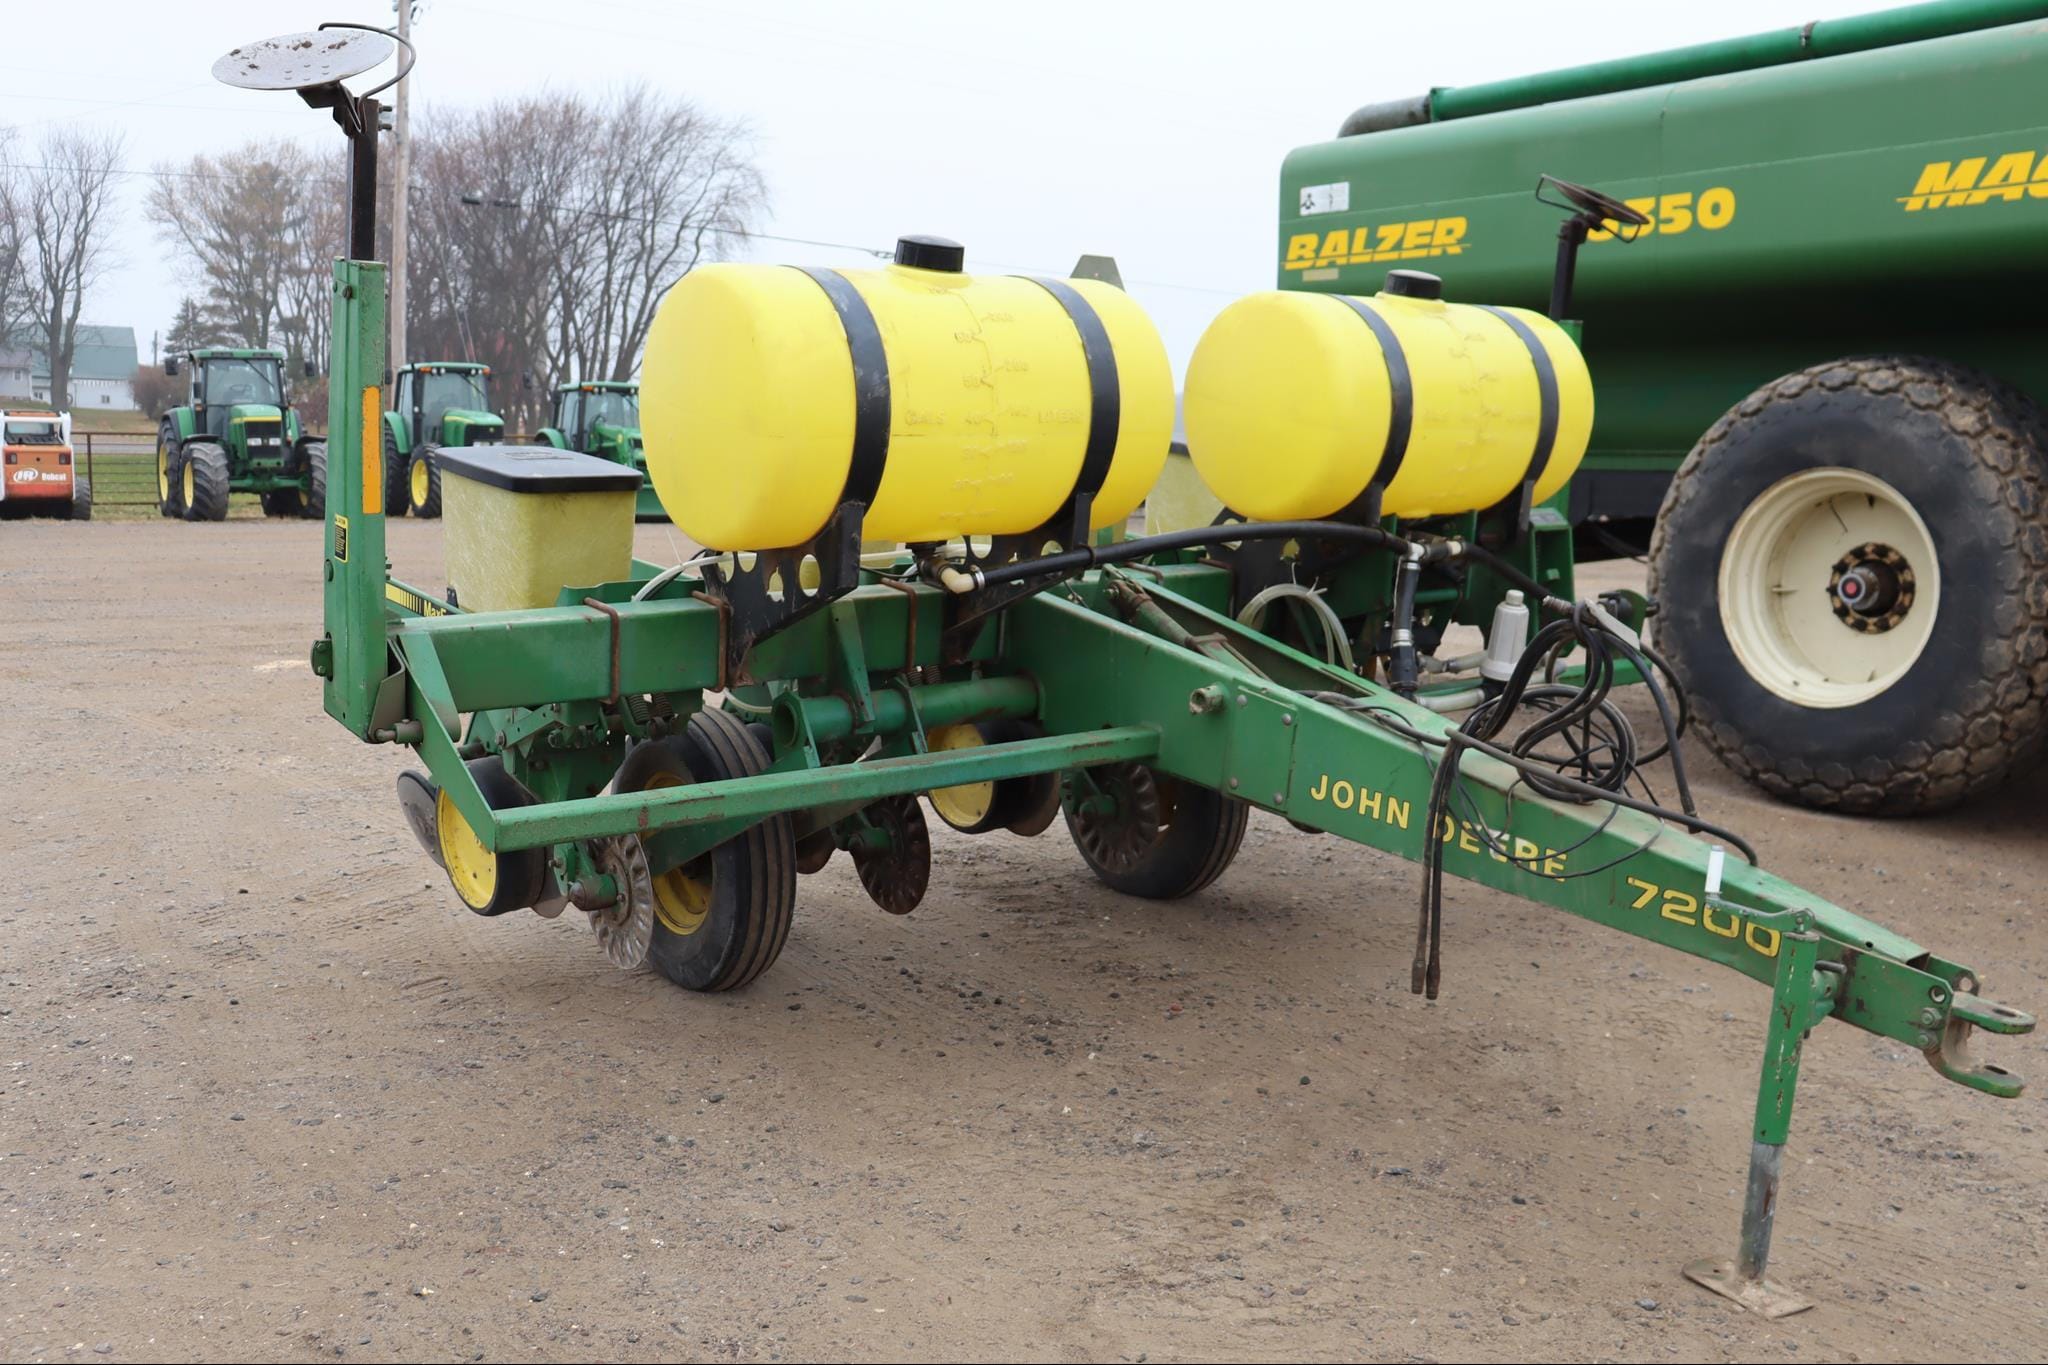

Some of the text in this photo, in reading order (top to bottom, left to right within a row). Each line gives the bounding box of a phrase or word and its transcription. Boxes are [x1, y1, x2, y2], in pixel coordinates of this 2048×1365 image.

[1284, 216, 1470, 271] BALZER
[1310, 774, 1411, 830] JOHN
[1432, 812, 1568, 883] DEERE
[1627, 876, 1781, 958] 7200
